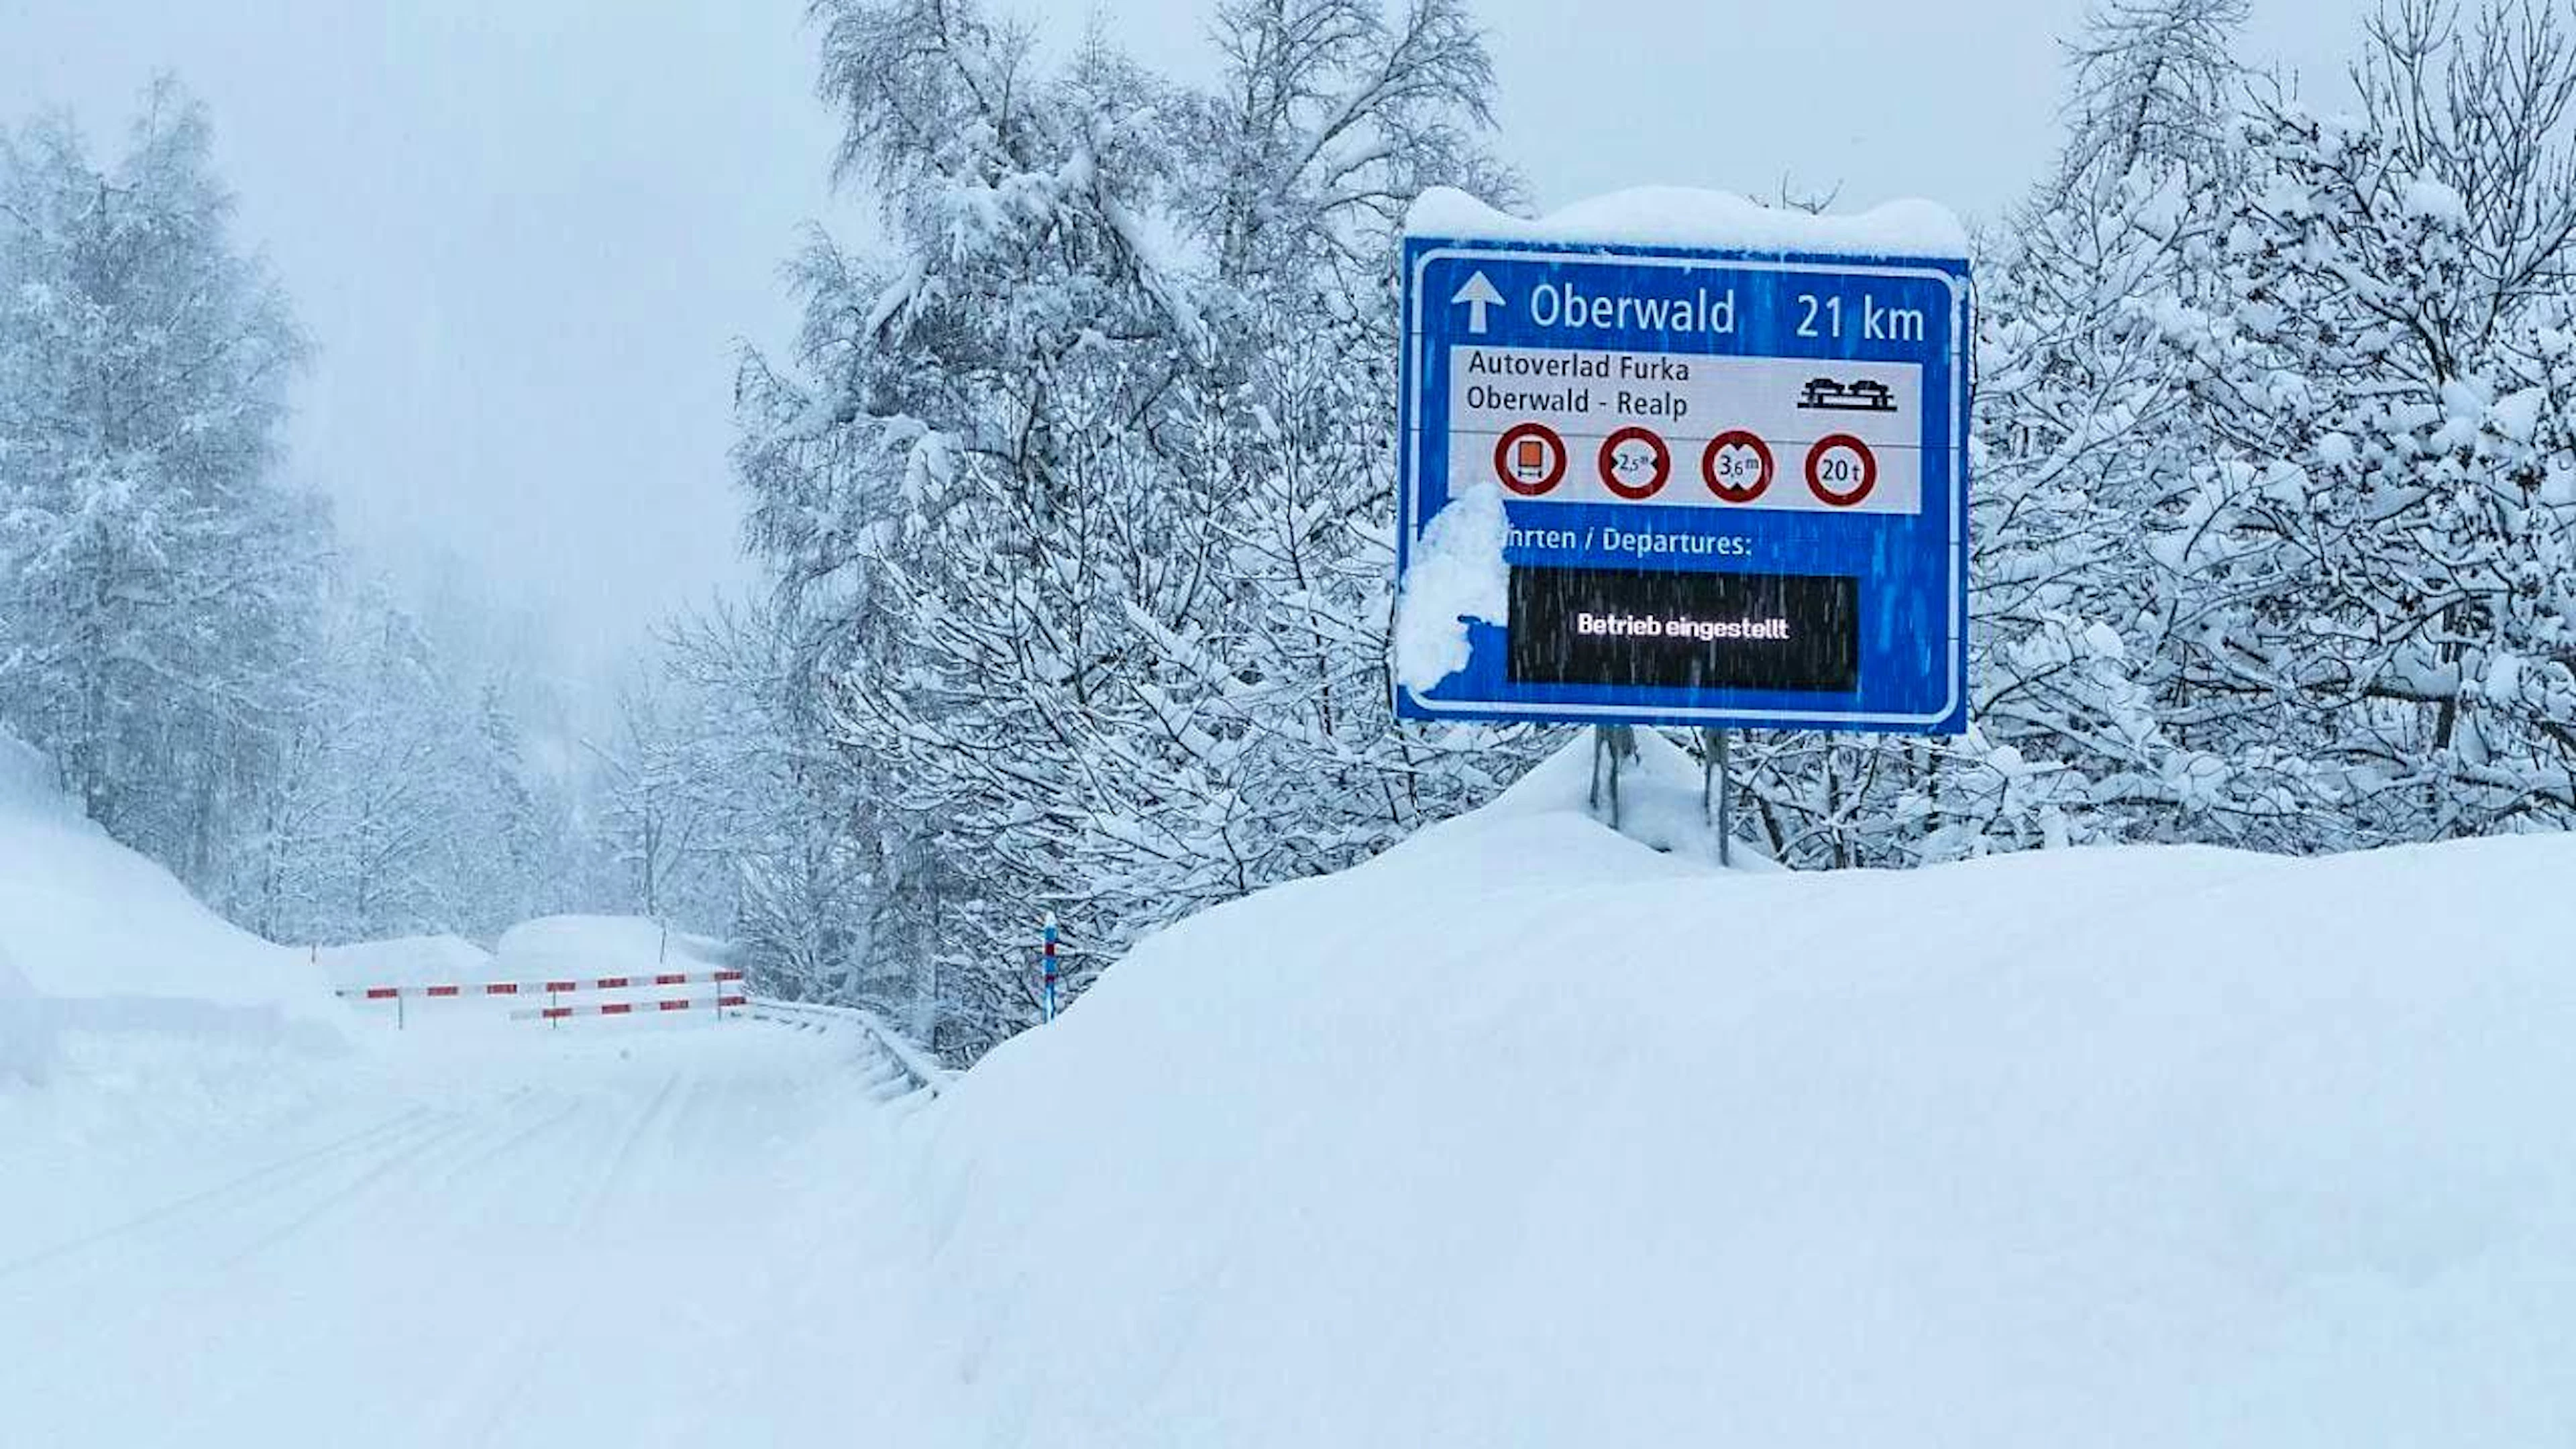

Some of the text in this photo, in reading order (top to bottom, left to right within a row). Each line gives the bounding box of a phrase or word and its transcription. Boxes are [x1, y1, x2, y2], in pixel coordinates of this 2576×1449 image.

[1531, 282, 1923, 341] Oberwald 21 km
[1468, 351, 1689, 380] Autoverlad Furka
[1467, 385, 1589, 413] Oberwald
[1617, 391, 1687, 422] Realp
[1585, 527, 1595, 551] /
[1603, 528, 1752, 559] Departures:
[1578, 613, 1790, 641] Betrieb eingestellt
